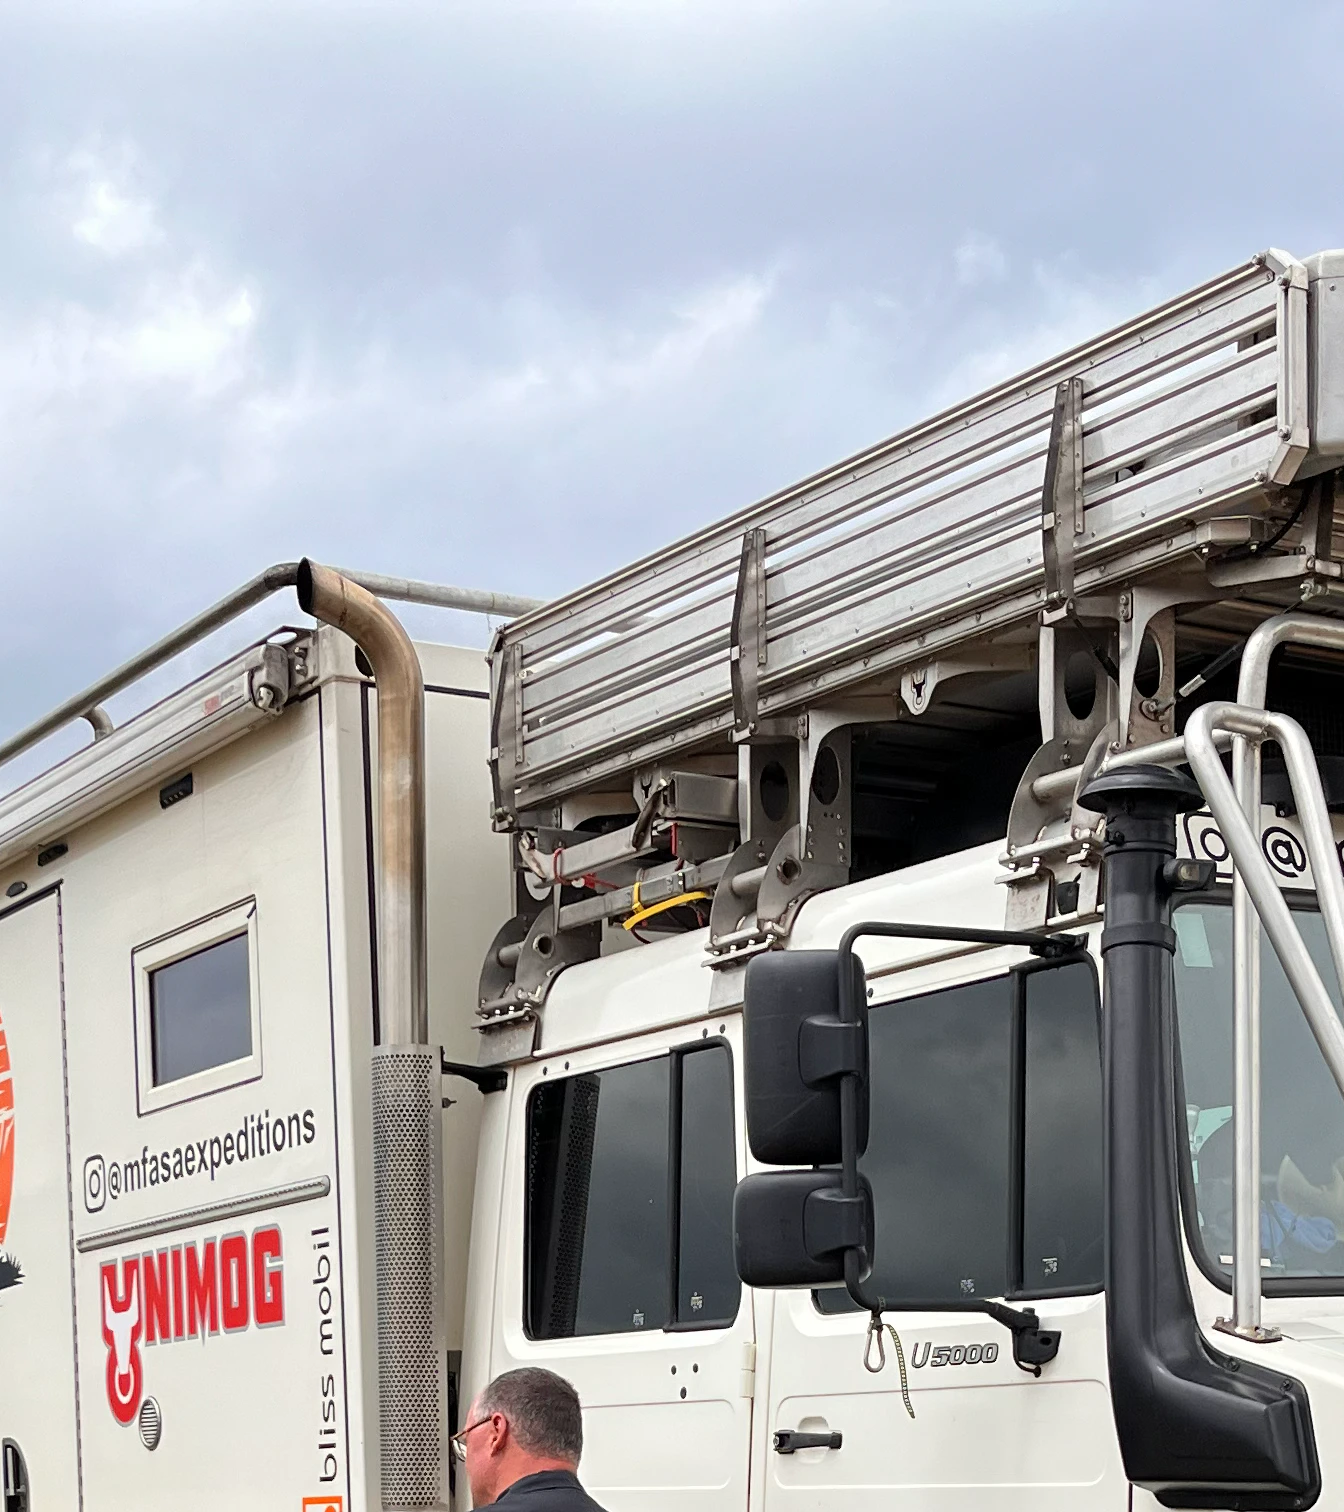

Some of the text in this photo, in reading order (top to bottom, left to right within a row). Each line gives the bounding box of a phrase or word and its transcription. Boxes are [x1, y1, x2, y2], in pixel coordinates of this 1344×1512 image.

[108, 1108, 316, 1200] @mfasaexpeditions
[99, 1222, 285, 1427] UNIMOG
[311, 1226, 338, 1483] bliss mobil
